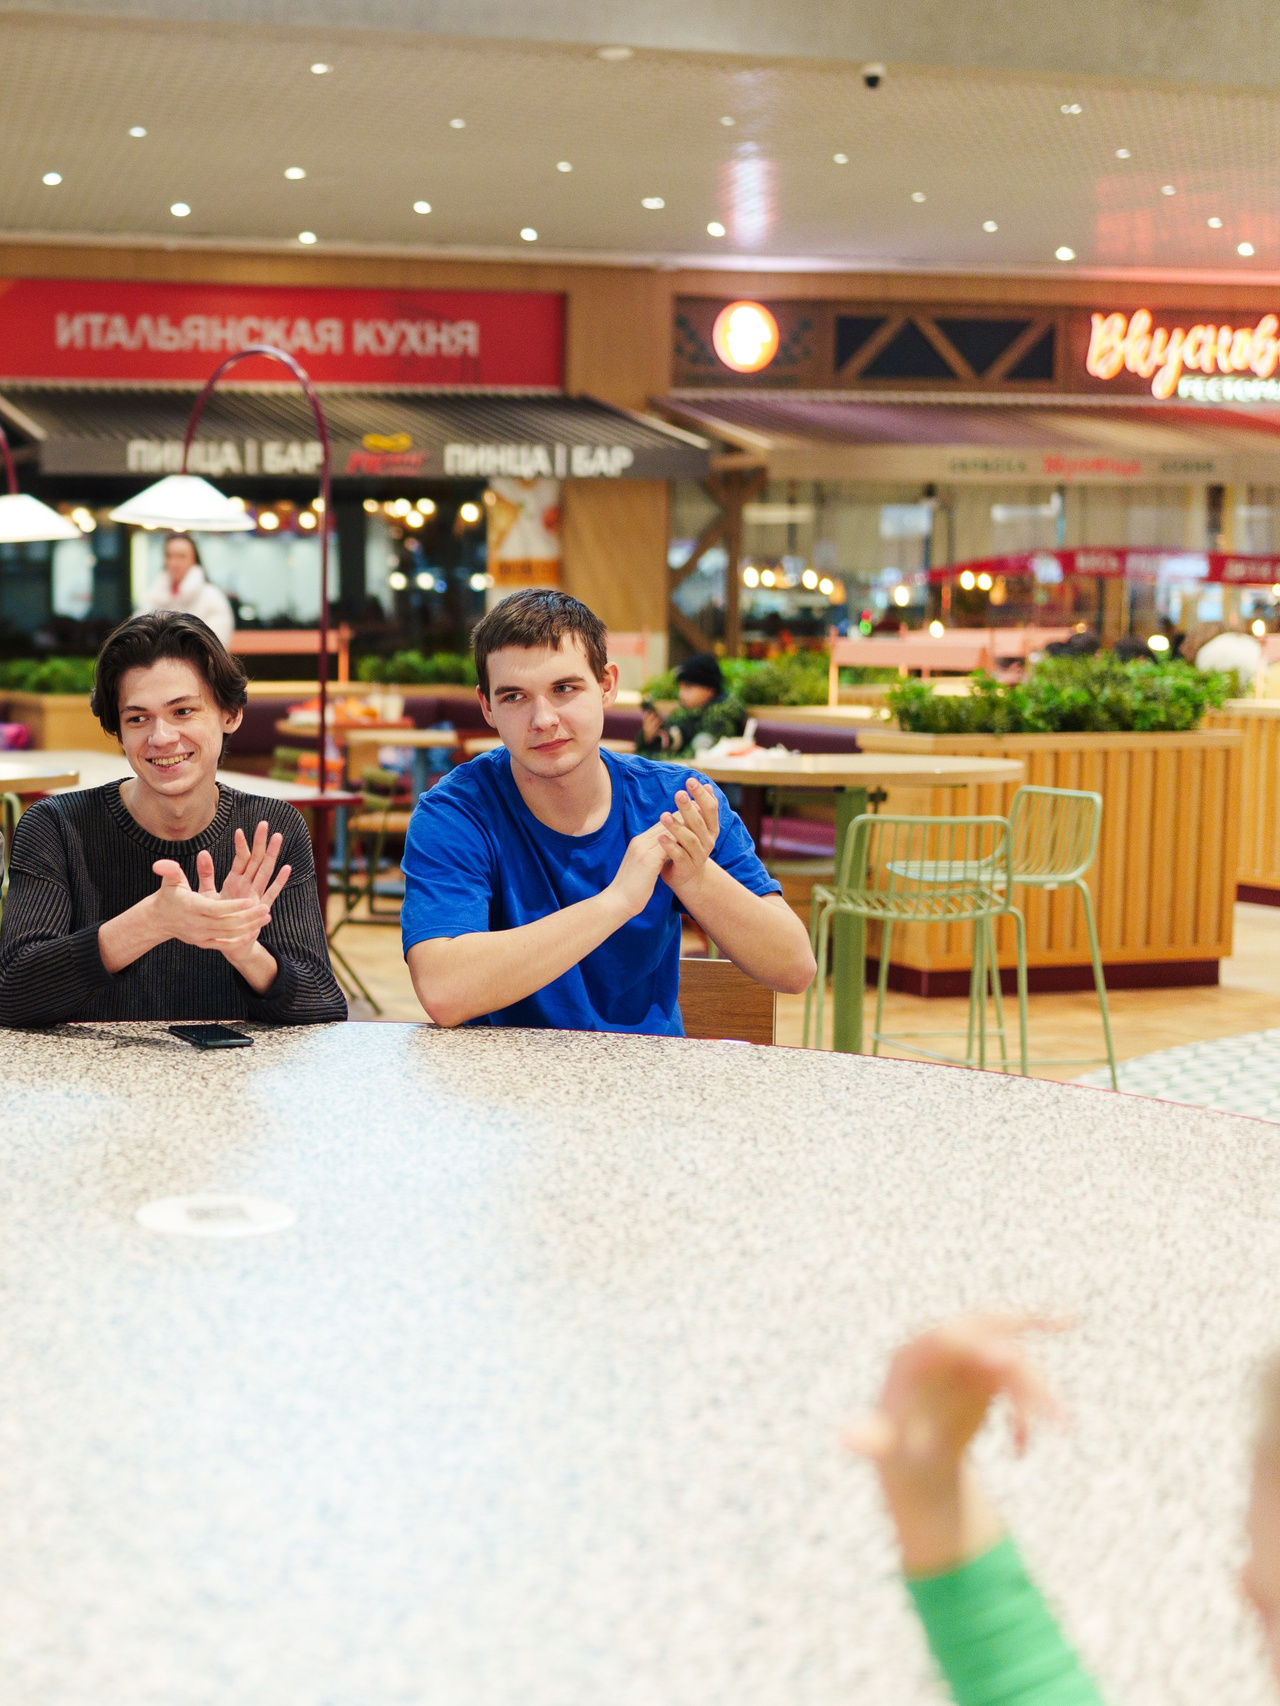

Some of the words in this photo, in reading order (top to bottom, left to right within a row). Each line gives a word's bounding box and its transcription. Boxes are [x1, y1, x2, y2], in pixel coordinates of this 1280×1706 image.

[55, 312, 344, 354] ИТАЛЬЯНСКАЯ
[352, 318, 480, 357] КУХНЯ
[1086, 308, 1280, 400] Вкуснов
[127, 439, 243, 476] ПИНЦА
[262, 441, 325, 475] БАР
[444, 443, 551, 479] ПИНЦА
[570, 445, 635, 478] БАР
